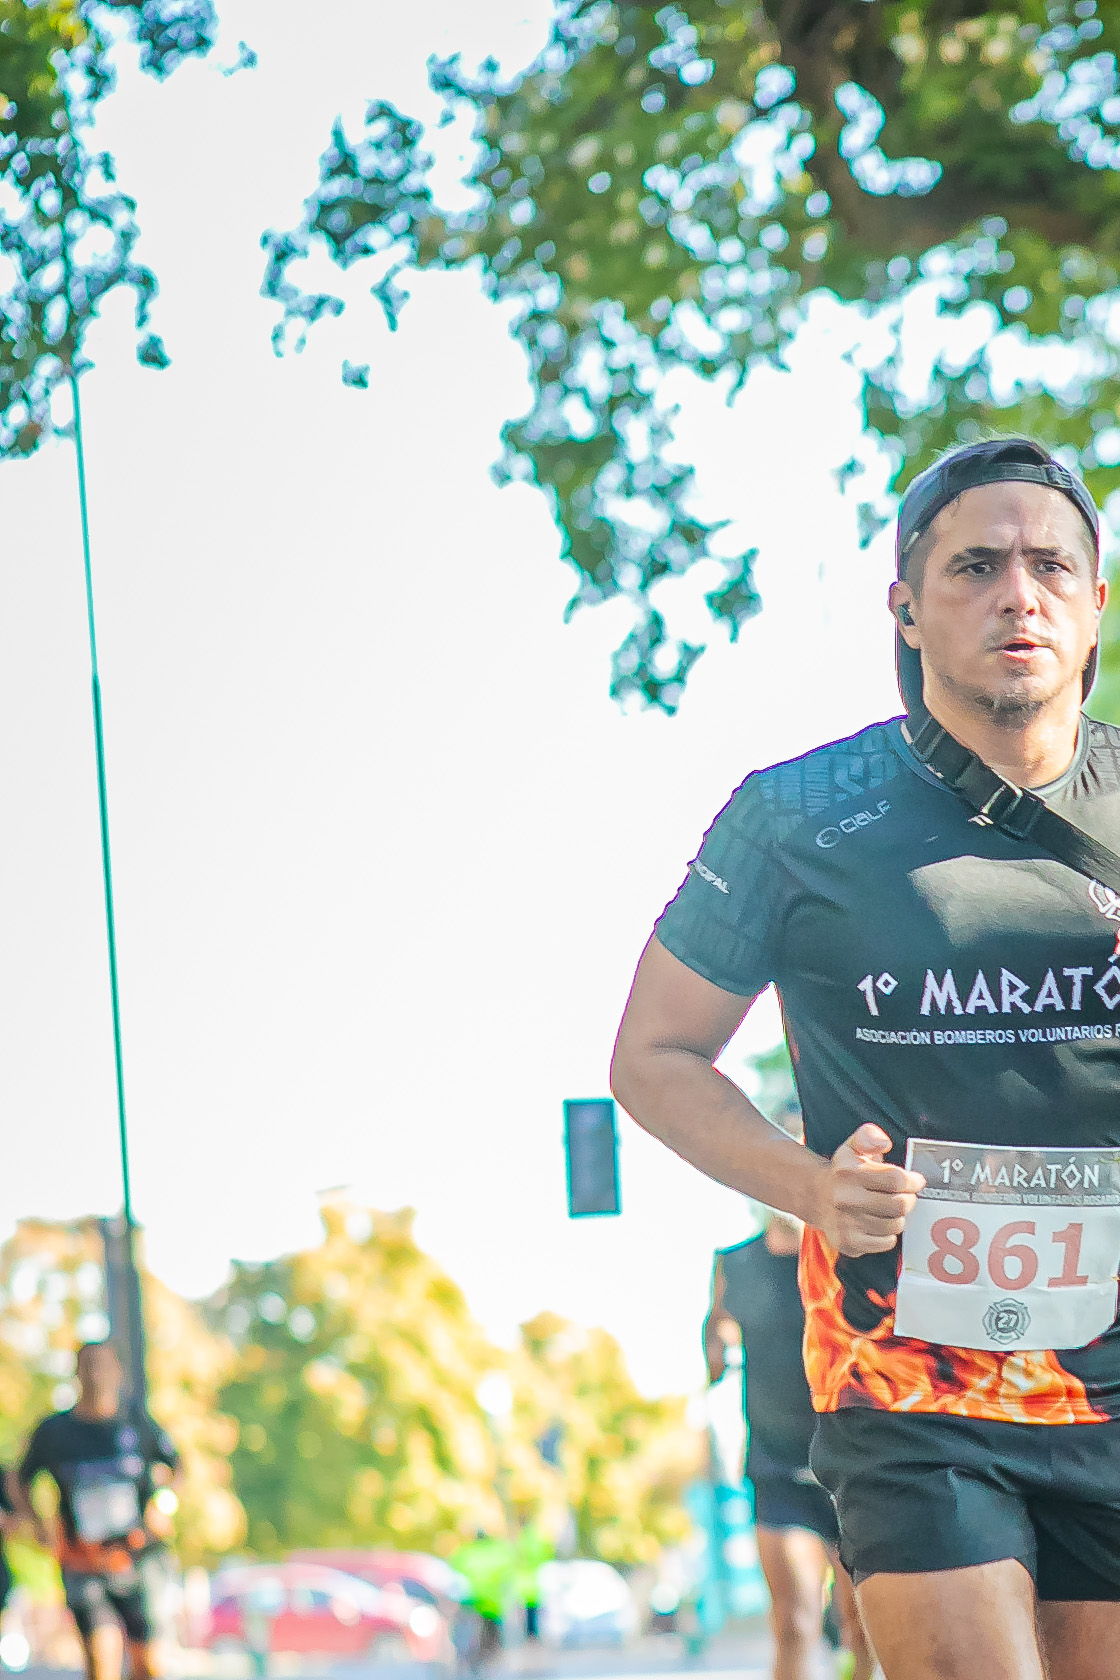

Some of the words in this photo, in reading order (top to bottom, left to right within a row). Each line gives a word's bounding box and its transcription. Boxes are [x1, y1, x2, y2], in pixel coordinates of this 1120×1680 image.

[933, 1029, 1016, 1045] BOMBEROS
[1018, 1024, 1113, 1043] VOLUNTARIOS
[969, 1155, 1101, 1189] MARATÓN
[926, 1216, 1090, 1291] 861
